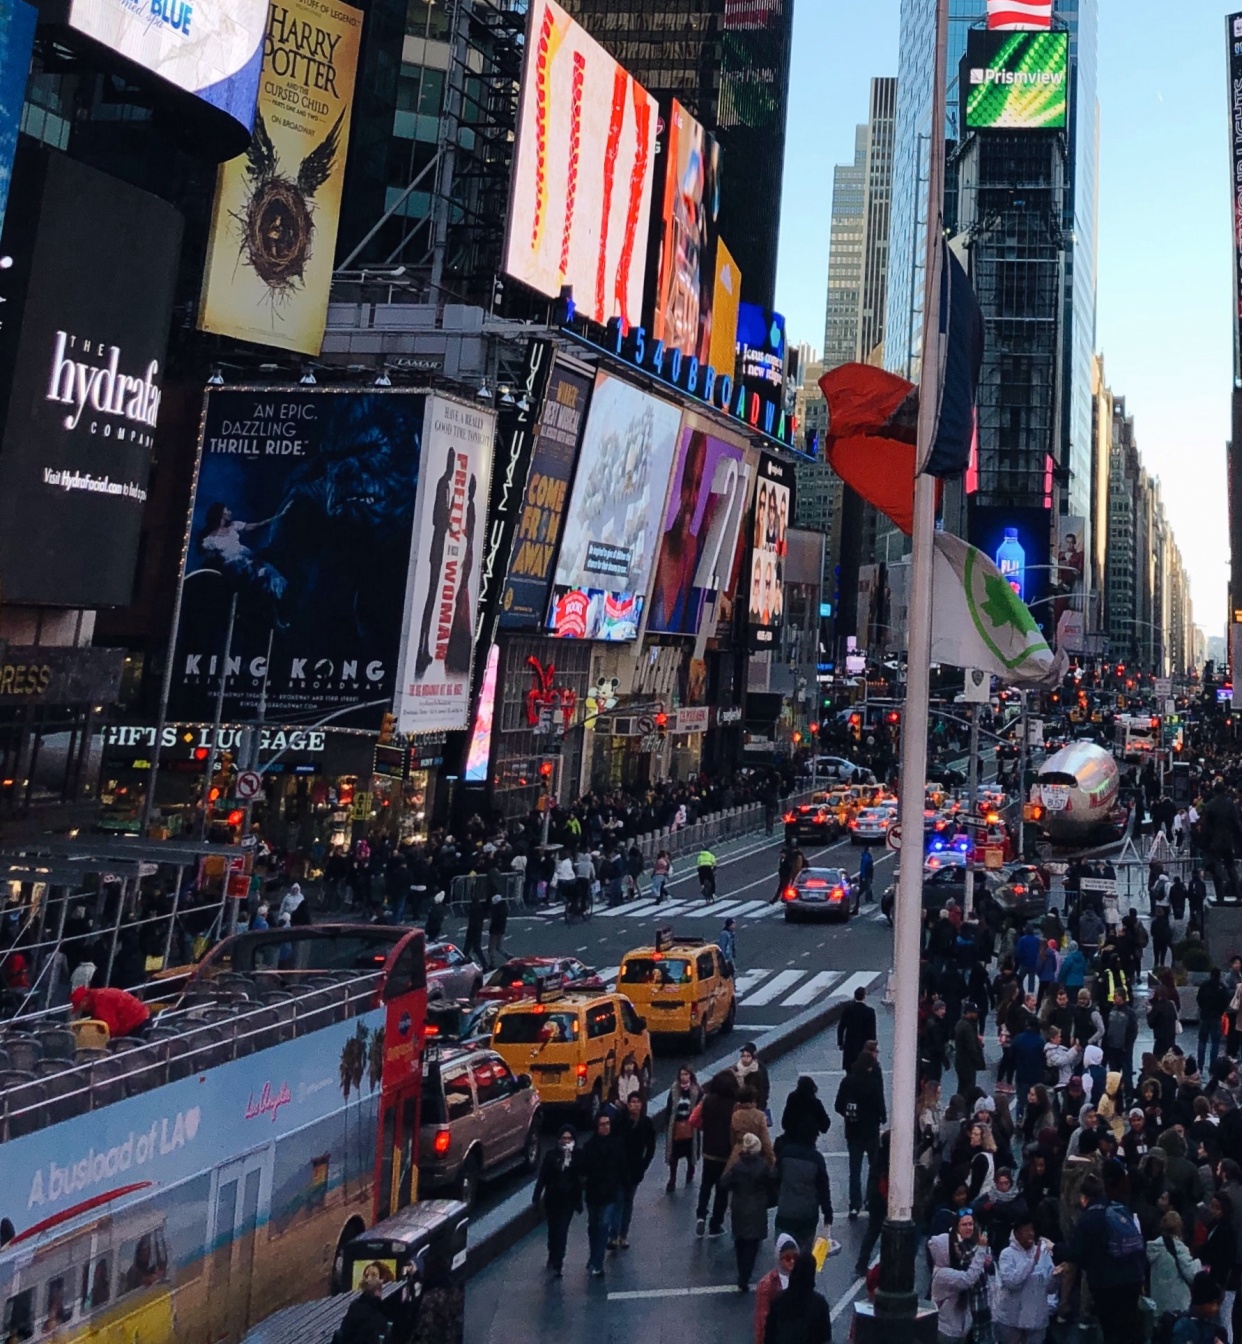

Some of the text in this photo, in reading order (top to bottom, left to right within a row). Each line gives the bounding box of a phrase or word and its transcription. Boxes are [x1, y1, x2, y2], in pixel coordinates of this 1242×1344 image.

[320, 4, 329, 14] OF
[266, 3, 342, 65] HARRY
[261, 36, 340, 99] POTTER
[985, 68, 1063, 84] Prismview
[264, 81, 329, 115] CURSED CHILD
[271, 115, 315, 136] ON BROADWAY
[70, 335, 105, 356] THE
[397, 358, 438, 369] LAMAR
[616, 316, 798, 445] 1540 BROADWAY
[280, 404, 318, 420] EPIC,
[444, 407, 459, 421] HAVE
[465, 414, 484, 429] REALLY
[222, 420, 297, 437] DAZZLING
[434, 420, 452, 435] GOOD
[453, 425, 467, 440] TIME
[210, 438, 260, 454] THRILL
[43, 467, 60, 485] Visit
[447, 453, 469, 543] PRETTY
[528, 472, 568, 513] COME
[511, 541, 555, 578] AWAY
[435, 560, 458, 661] WOMAN
[185, 654, 386, 681] KING KONG
[0, 664, 51, 694] RESS
[289, 681, 383, 690] BROADWAY
[28, 1169, 45, 1207] A
[50, 1132, 133, 1195] busload
[136, 1120, 158, 1165] of
